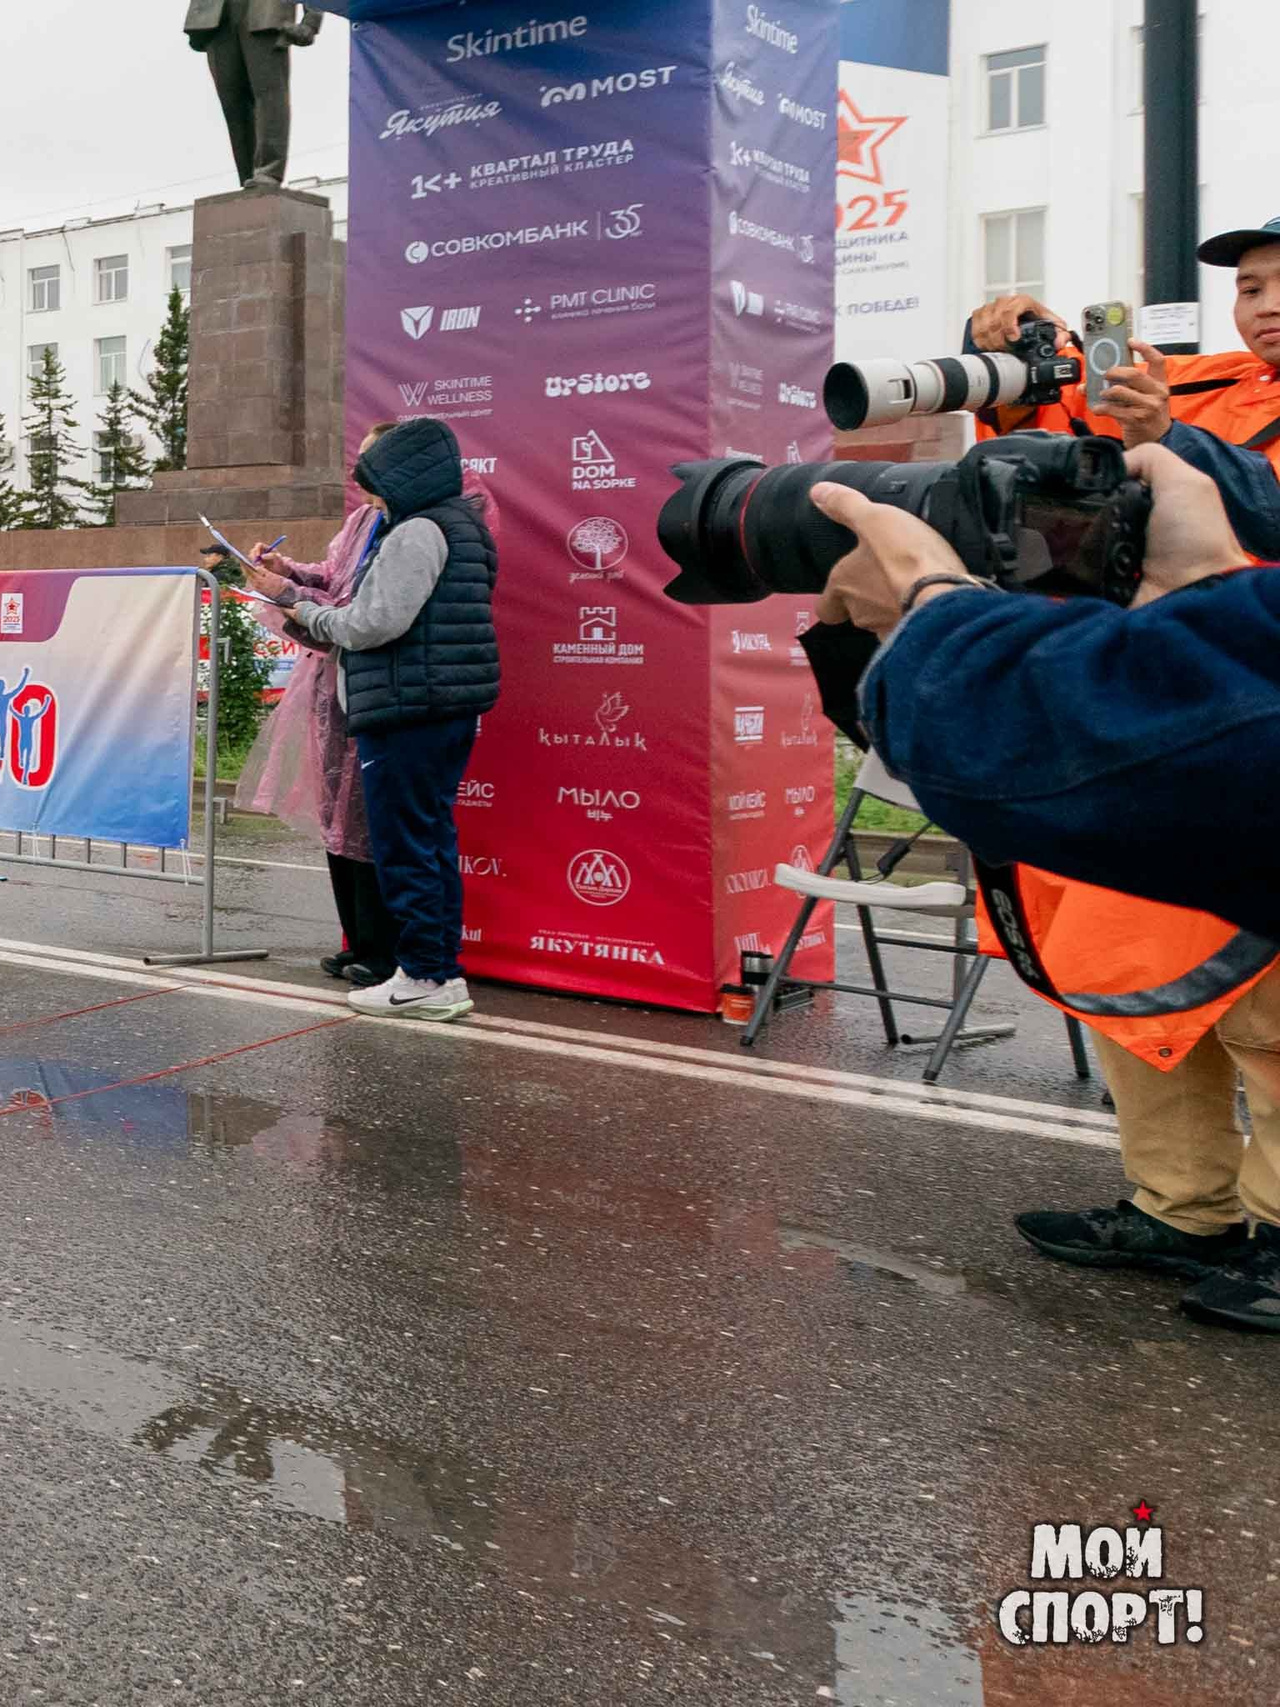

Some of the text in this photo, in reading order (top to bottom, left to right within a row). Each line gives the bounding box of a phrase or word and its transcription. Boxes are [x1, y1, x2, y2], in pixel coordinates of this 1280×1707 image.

[446, 15, 588, 63] Skintime
[745, 4, 798, 54] Skintime
[591, 65, 678, 98] MOST
[379, 101, 503, 139] Якутия
[469, 153, 635, 190] КРЕАТИВНЫЙ КЛАСТЕР
[470, 138, 635, 179] КВАРТАЛ ТРУДА
[431, 219, 589, 258] СОВКОМБАНК
[550, 283, 656, 310] PMT CLINIC
[848, 297, 920, 315] ПОБЕДЕ!
[439, 305, 481, 331] IRON
[434, 376, 493, 392] SKINTIME
[427, 390, 493, 406] WELLNESS
[572, 465, 616, 479] DOM
[572, 477, 636, 490] NA SOPKE
[553, 643, 644, 655] КАМЕННЫЙ ДОМ
[557, 786, 640, 809] МЫЛО
[530, 936, 665, 965] ЯКУТЯНКА
